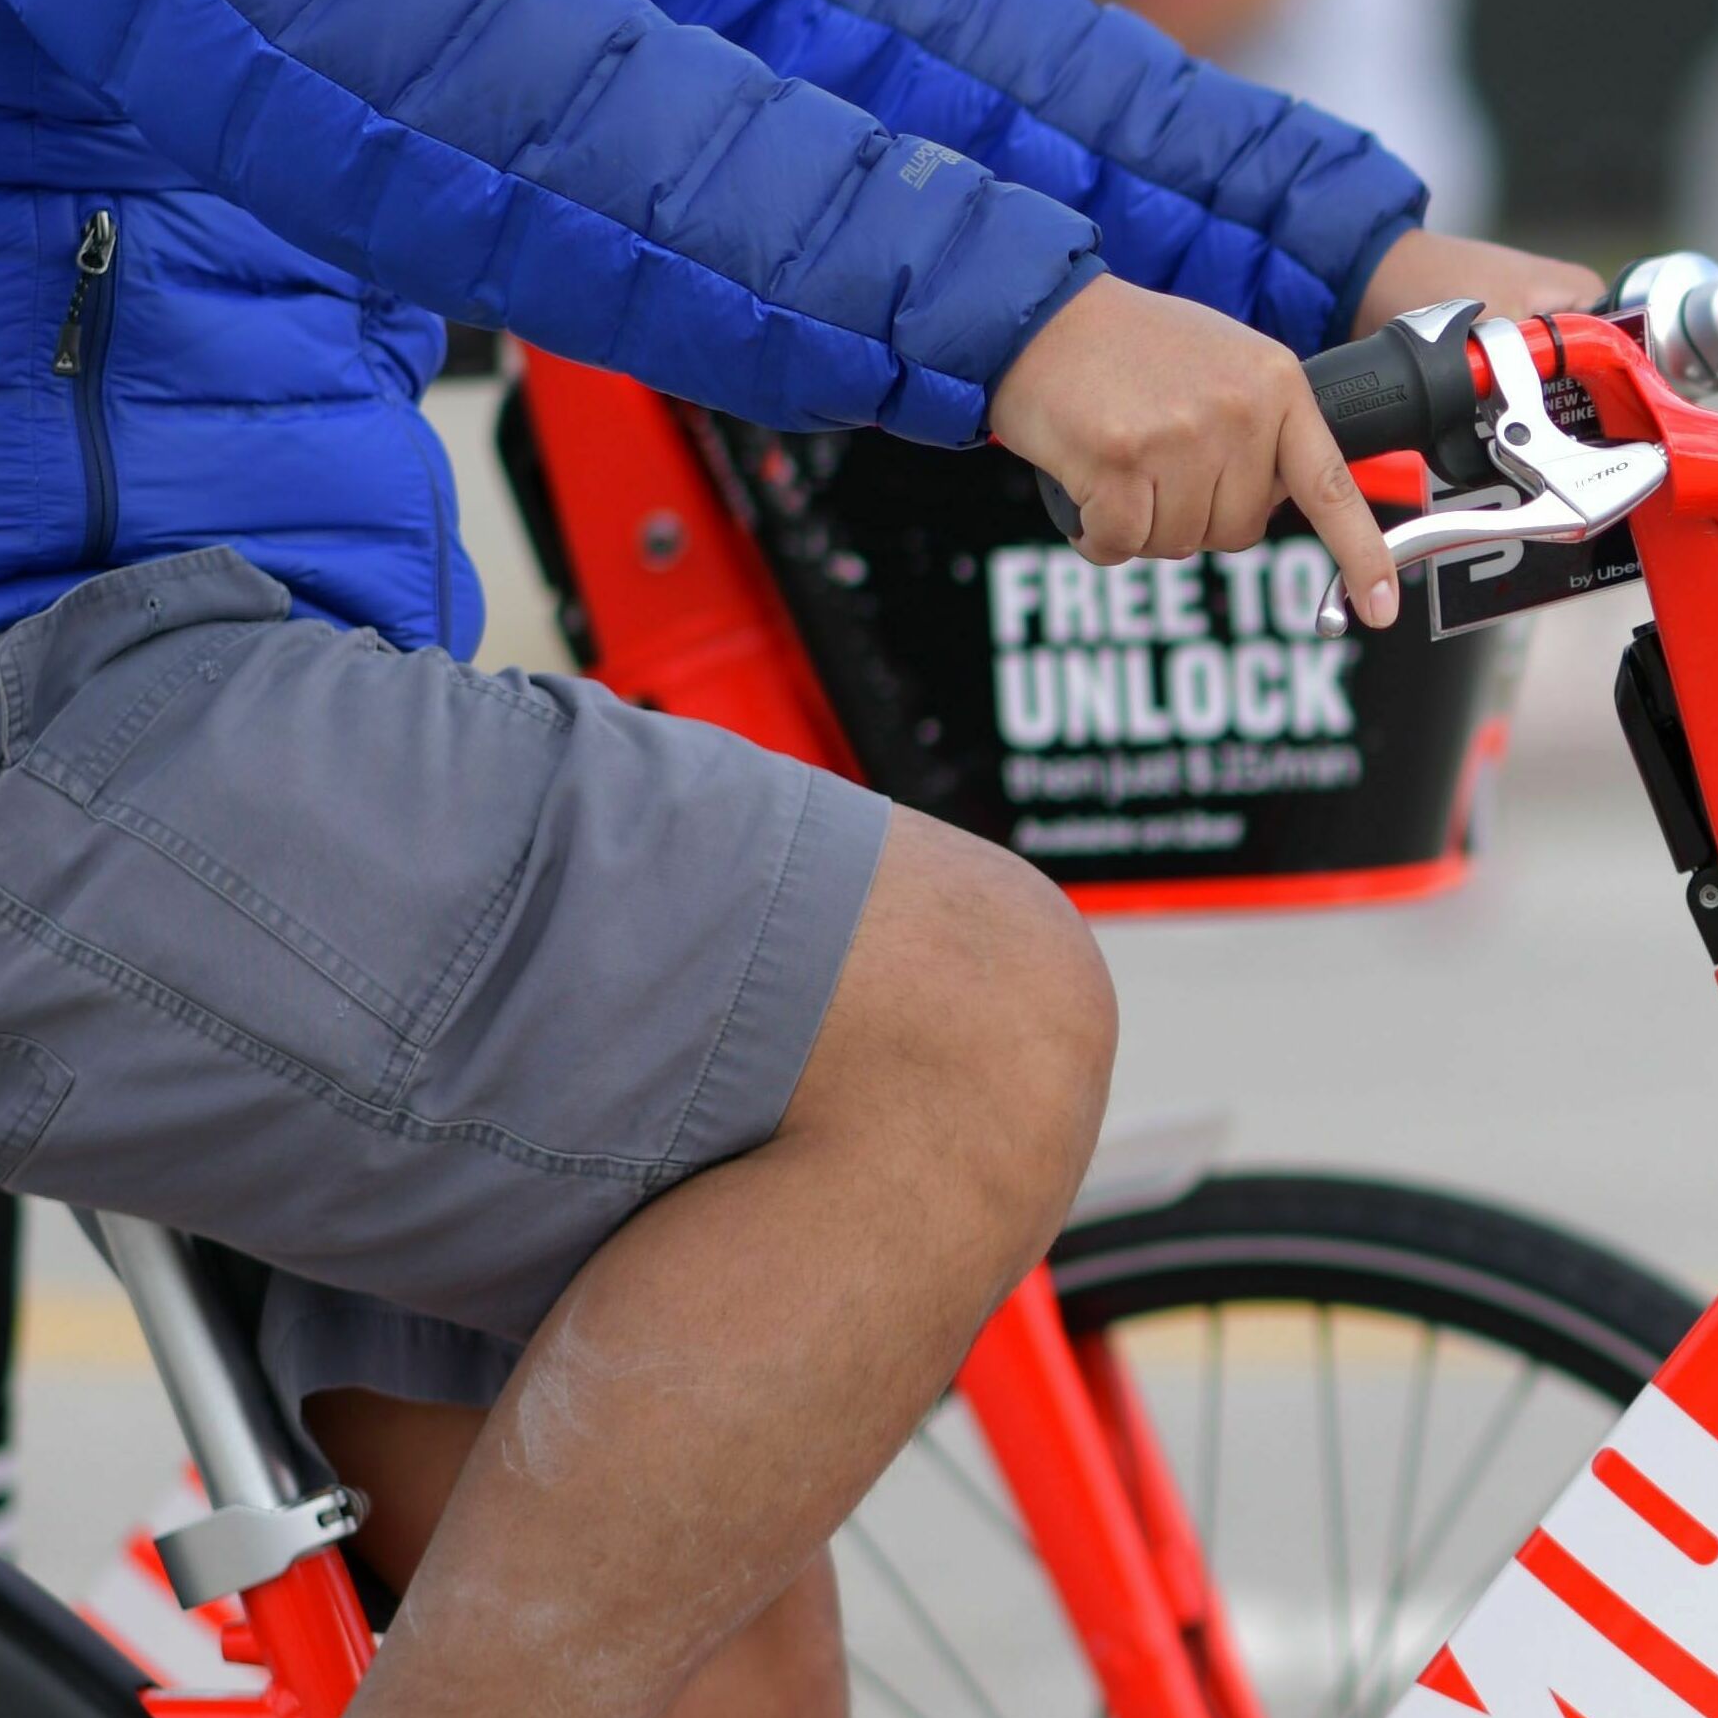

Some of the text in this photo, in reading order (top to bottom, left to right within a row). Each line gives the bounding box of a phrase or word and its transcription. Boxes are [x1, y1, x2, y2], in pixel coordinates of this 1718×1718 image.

[1543, 377, 1582, 396] MEE
[1550, 404, 1597, 425] -BIKE
[989, 538, 1332, 642] FREE TO
[1569, 574, 1593, 588] by
[995, 640, 1357, 748] UNLOCK
